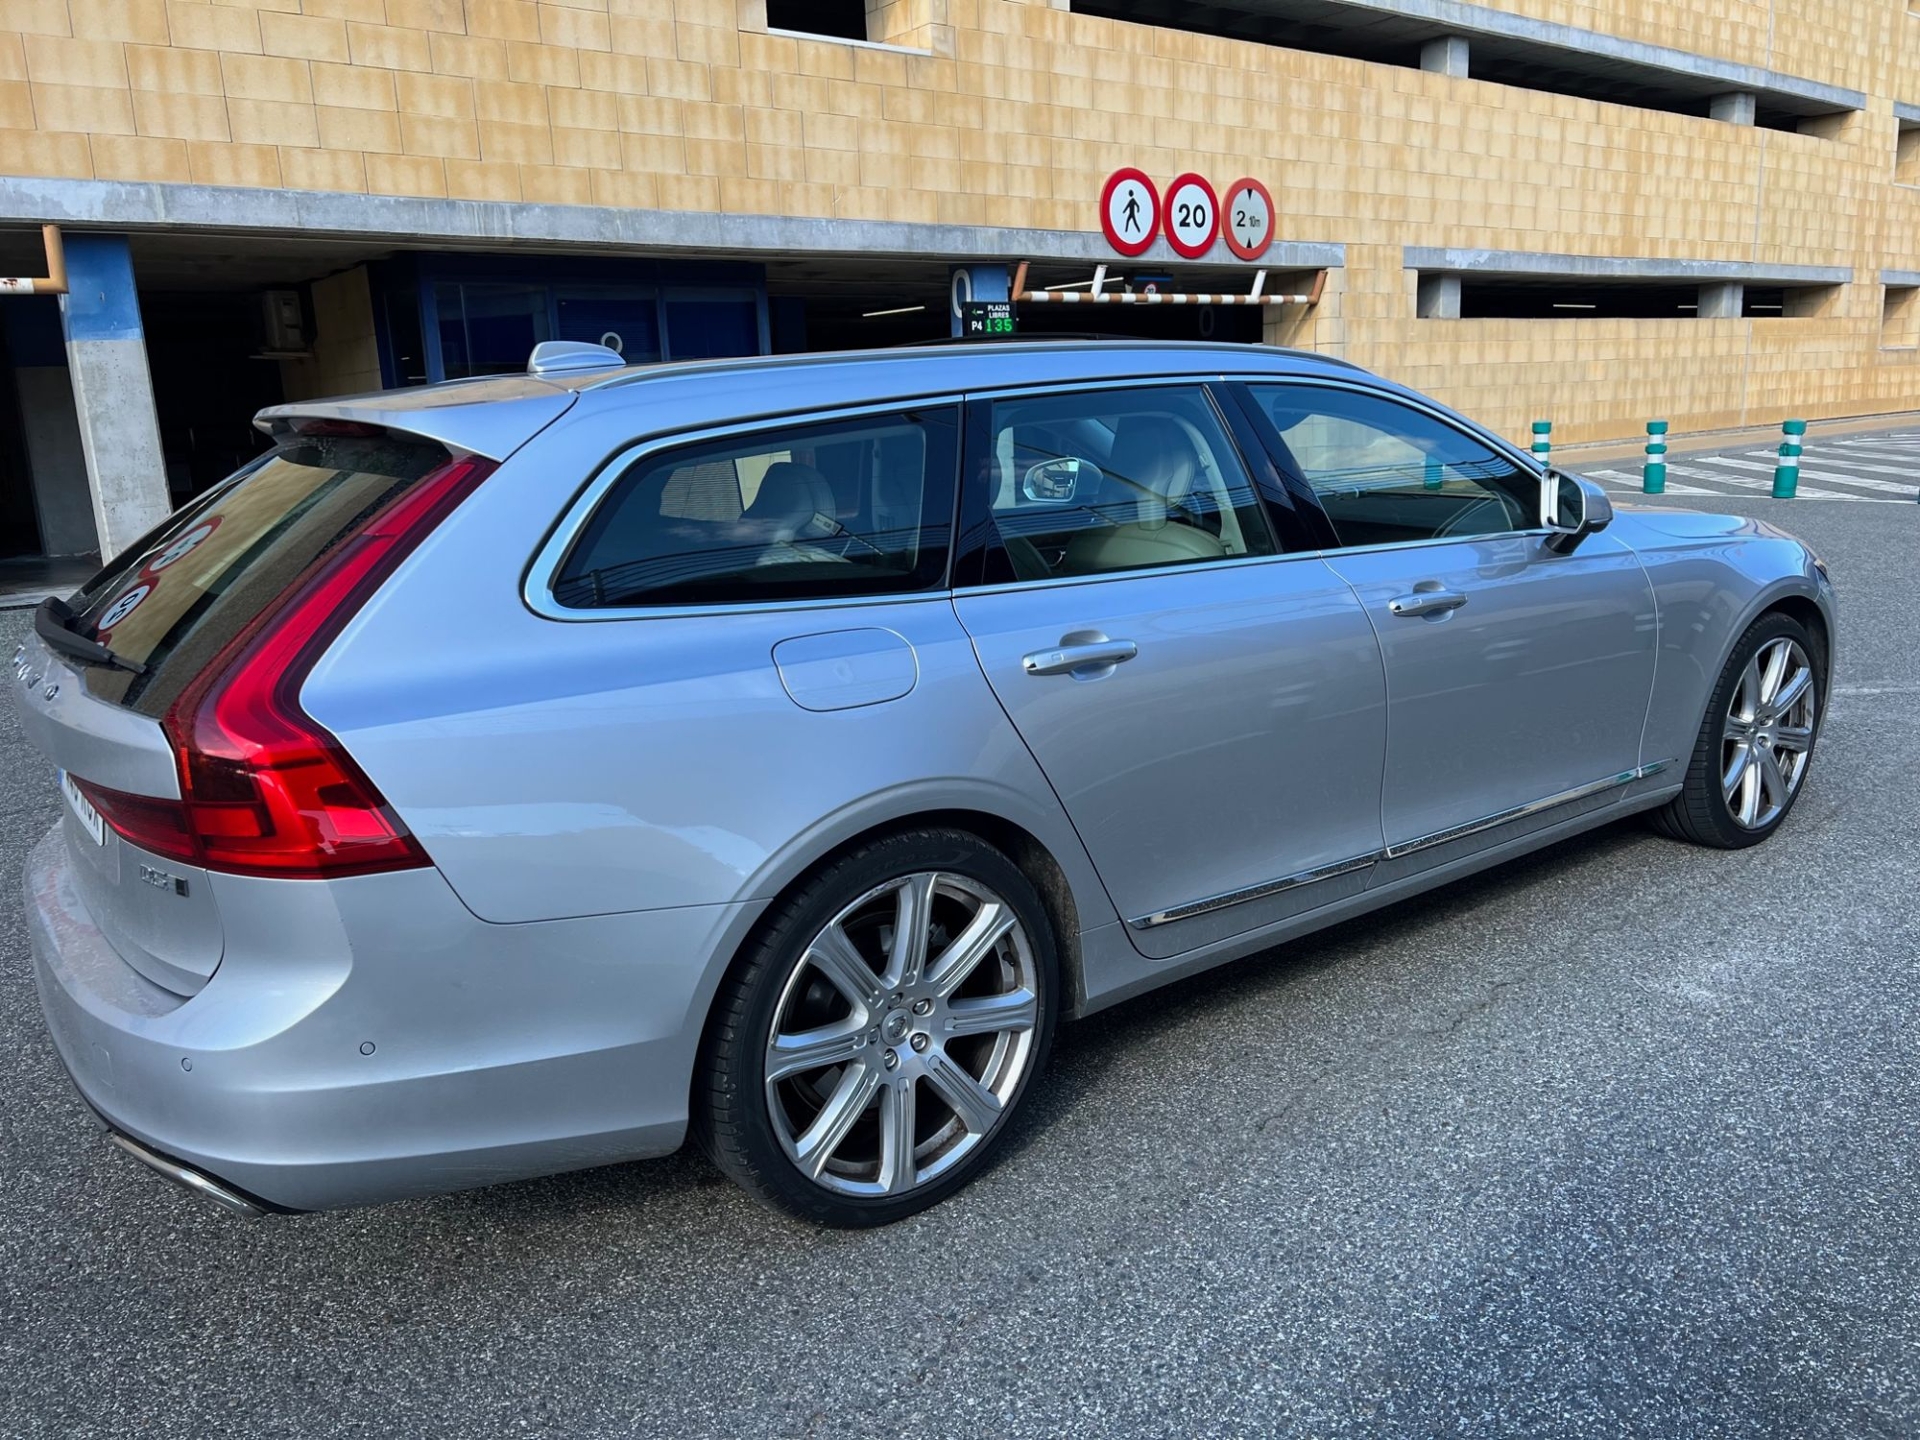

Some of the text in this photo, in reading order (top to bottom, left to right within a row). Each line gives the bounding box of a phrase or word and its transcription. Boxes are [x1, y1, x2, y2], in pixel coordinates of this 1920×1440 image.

[1178, 203, 1206, 228] 20
[1236, 210, 1246, 227] 2
[988, 311, 1010, 319] LIBRES
[971, 318, 1012, 332] P4 135
